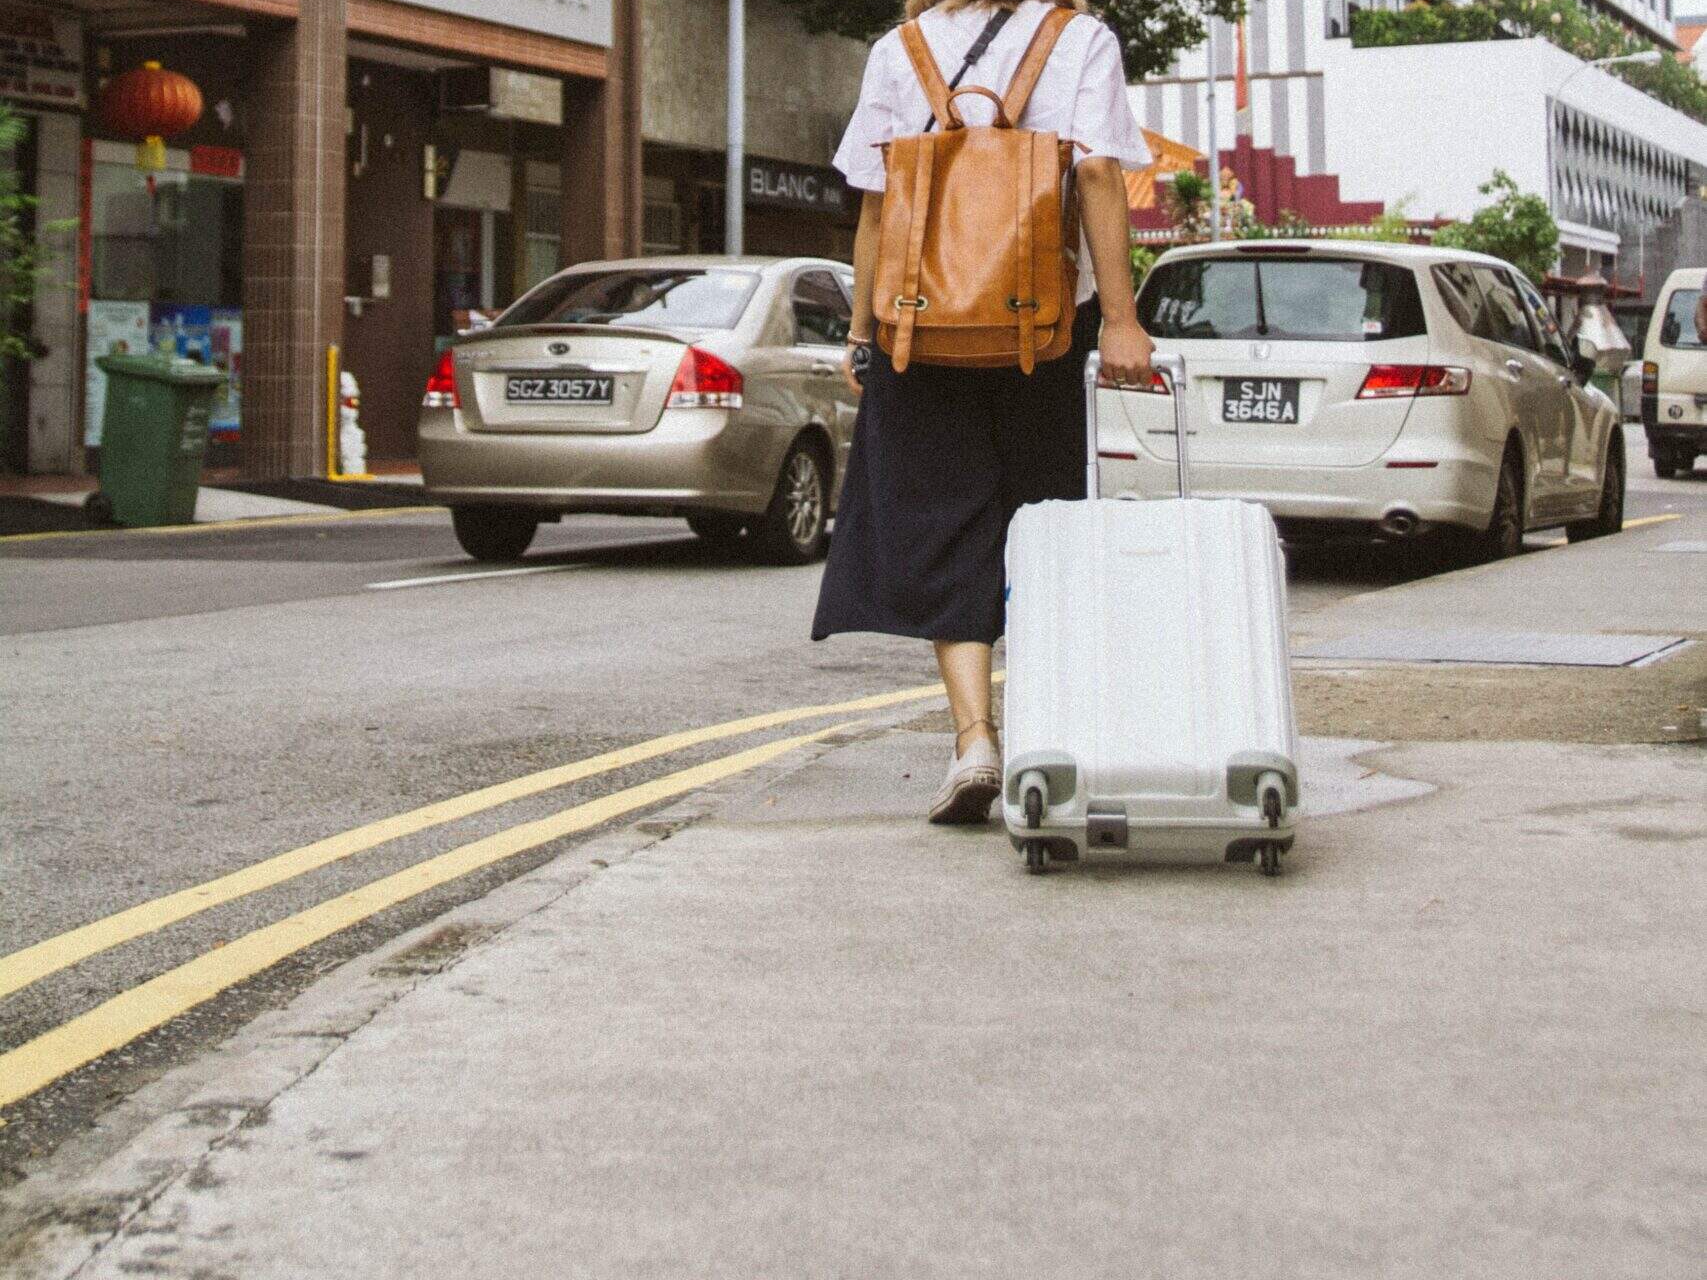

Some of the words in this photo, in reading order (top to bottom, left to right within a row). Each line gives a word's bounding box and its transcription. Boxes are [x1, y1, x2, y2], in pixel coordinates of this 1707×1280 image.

[750, 167, 817, 202] BLANC
[508, 379, 543, 398] SGZ
[547, 379, 610, 398] 3057Y
[1241, 381, 1281, 400] SJN
[1225, 400, 1294, 420] 3646A
